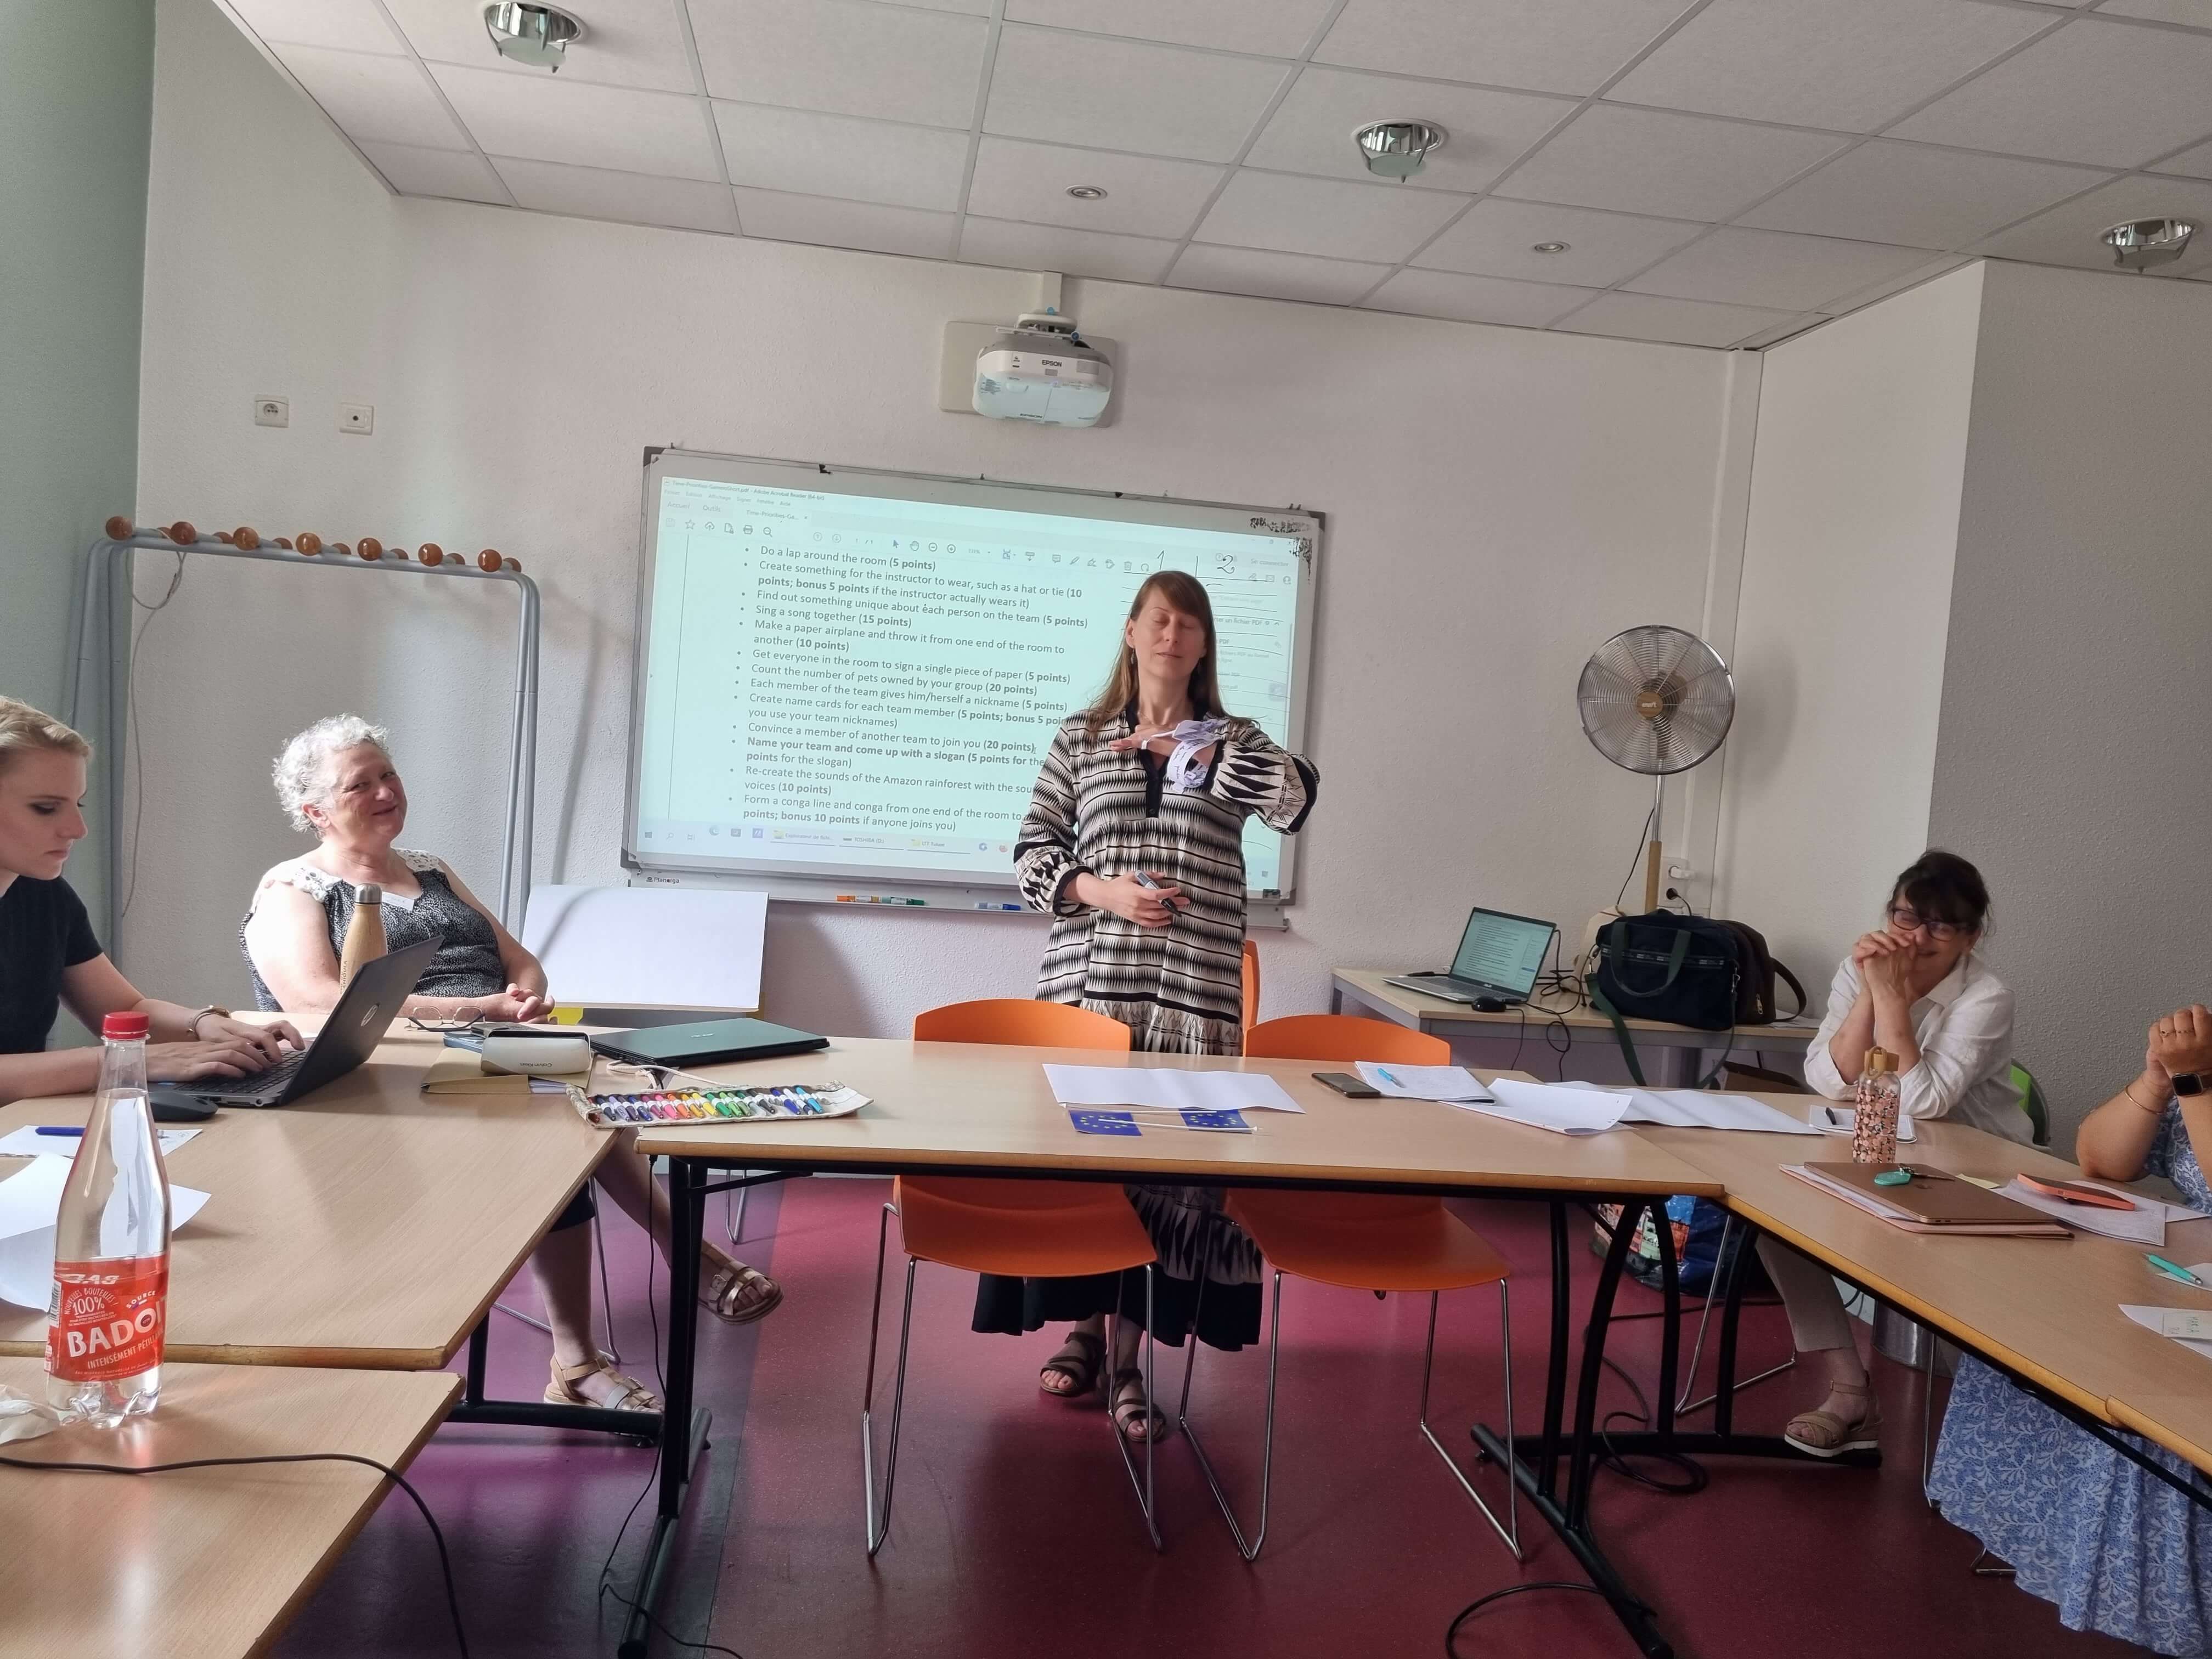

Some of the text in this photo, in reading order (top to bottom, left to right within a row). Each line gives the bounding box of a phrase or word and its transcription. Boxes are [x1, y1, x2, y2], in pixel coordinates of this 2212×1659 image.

[760, 545, 774, 555] Do
[786, 547, 800, 559] lap
[803, 552, 839, 561] around
[842, 552, 857, 563] the
[860, 557, 886, 566] room
[889, 557, 899, 568] (5
[901, 559, 935, 572] points)
[1217, 555, 1235, 574] 2
[758, 576, 1029, 610] points; bonus 5 points if the instructor actually wears it)
[759, 560, 792, 571] Create
[794, 566, 847, 579] something
[849, 568, 864, 578] for
[866, 569, 882, 579] the
[885, 571, 932, 584] instructor
[934, 577, 944, 585] to
[947, 579, 973, 590] wear,
[977, 580, 997, 590] such
[1021, 583, 1036, 594] hat
[1052, 587, 1064, 596] tie
[1066, 588, 1082, 599] (10
[755, 605, 777, 617] Sing
[787, 610, 810, 620] song
[814, 611, 856, 622] together
[859, 613, 874, 624] (15
[877, 616, 911, 629] points)
[757, 590, 778, 600] Find
[781, 594, 798, 602] out
[800, 596, 852, 608] something
[855, 600, 888, 610] unique
[891, 601, 919, 612] about
[922, 605, 944, 614] each
[947, 609, 980, 618] person
[997, 611, 1013, 620] the
[1015, 613, 1040, 623] team
[1043, 614, 1052, 625] (5
[1054, 617, 1087, 629] points)
[752, 663, 1037, 696] Count the number of pets owned by your group (20 points)
[751, 678, 774, 688] Each
[777, 681, 819, 692] member
[821, 684, 832, 693] of
[834, 684, 850, 694] the
[853, 687, 878, 696] team
[880, 689, 905, 699] gives
[907, 690, 964, 703] him/herself
[974, 696, 1019, 707] nickname
[1022, 699, 1031, 710] (5
[1034, 701, 1067, 713] points)
[748, 709, 766, 718] you
[789, 713, 812, 721] your
[815, 713, 839, 723] team
[843, 715, 897, 729] nicknames)
[749, 693, 1063, 727] Create name cards for each team member (5 points; bonus 5 poi
[746, 752, 851, 768] points for the slogan)
[747, 737, 777, 747] Name
[780, 741, 803, 750] your
[805, 742, 831, 751] team
[834, 744, 853, 753] and
[855, 747, 883, 755] come
[885, 749, 898, 758] up
[900, 748, 922, 758] with
[934, 750, 964, 762] slogan
[968, 752, 977, 763] (5
[979, 754, 1009, 764] points
[1012, 755, 1027, 765] for
[1029, 757, 1043, 766] the
[744, 781, 831, 796] voices (10 points)
[746, 765, 793, 777] Re-create
[795, 769, 811, 778] the
[815, 772, 849, 781] sounds
[852, 773, 863, 781] of
[865, 774, 881, 783] the
[883, 775, 922, 786] Amazon
[925, 778, 971, 789] rainforest
[974, 782, 995, 791] with
[997, 782, 1013, 792] the
[72, 1296, 105, 1316] 100%
[126, 1290, 156, 1308] SOURCE
[67, 1300, 163, 1357] BADOI
[87, 1346, 136, 1370] INTENSÉMENT
